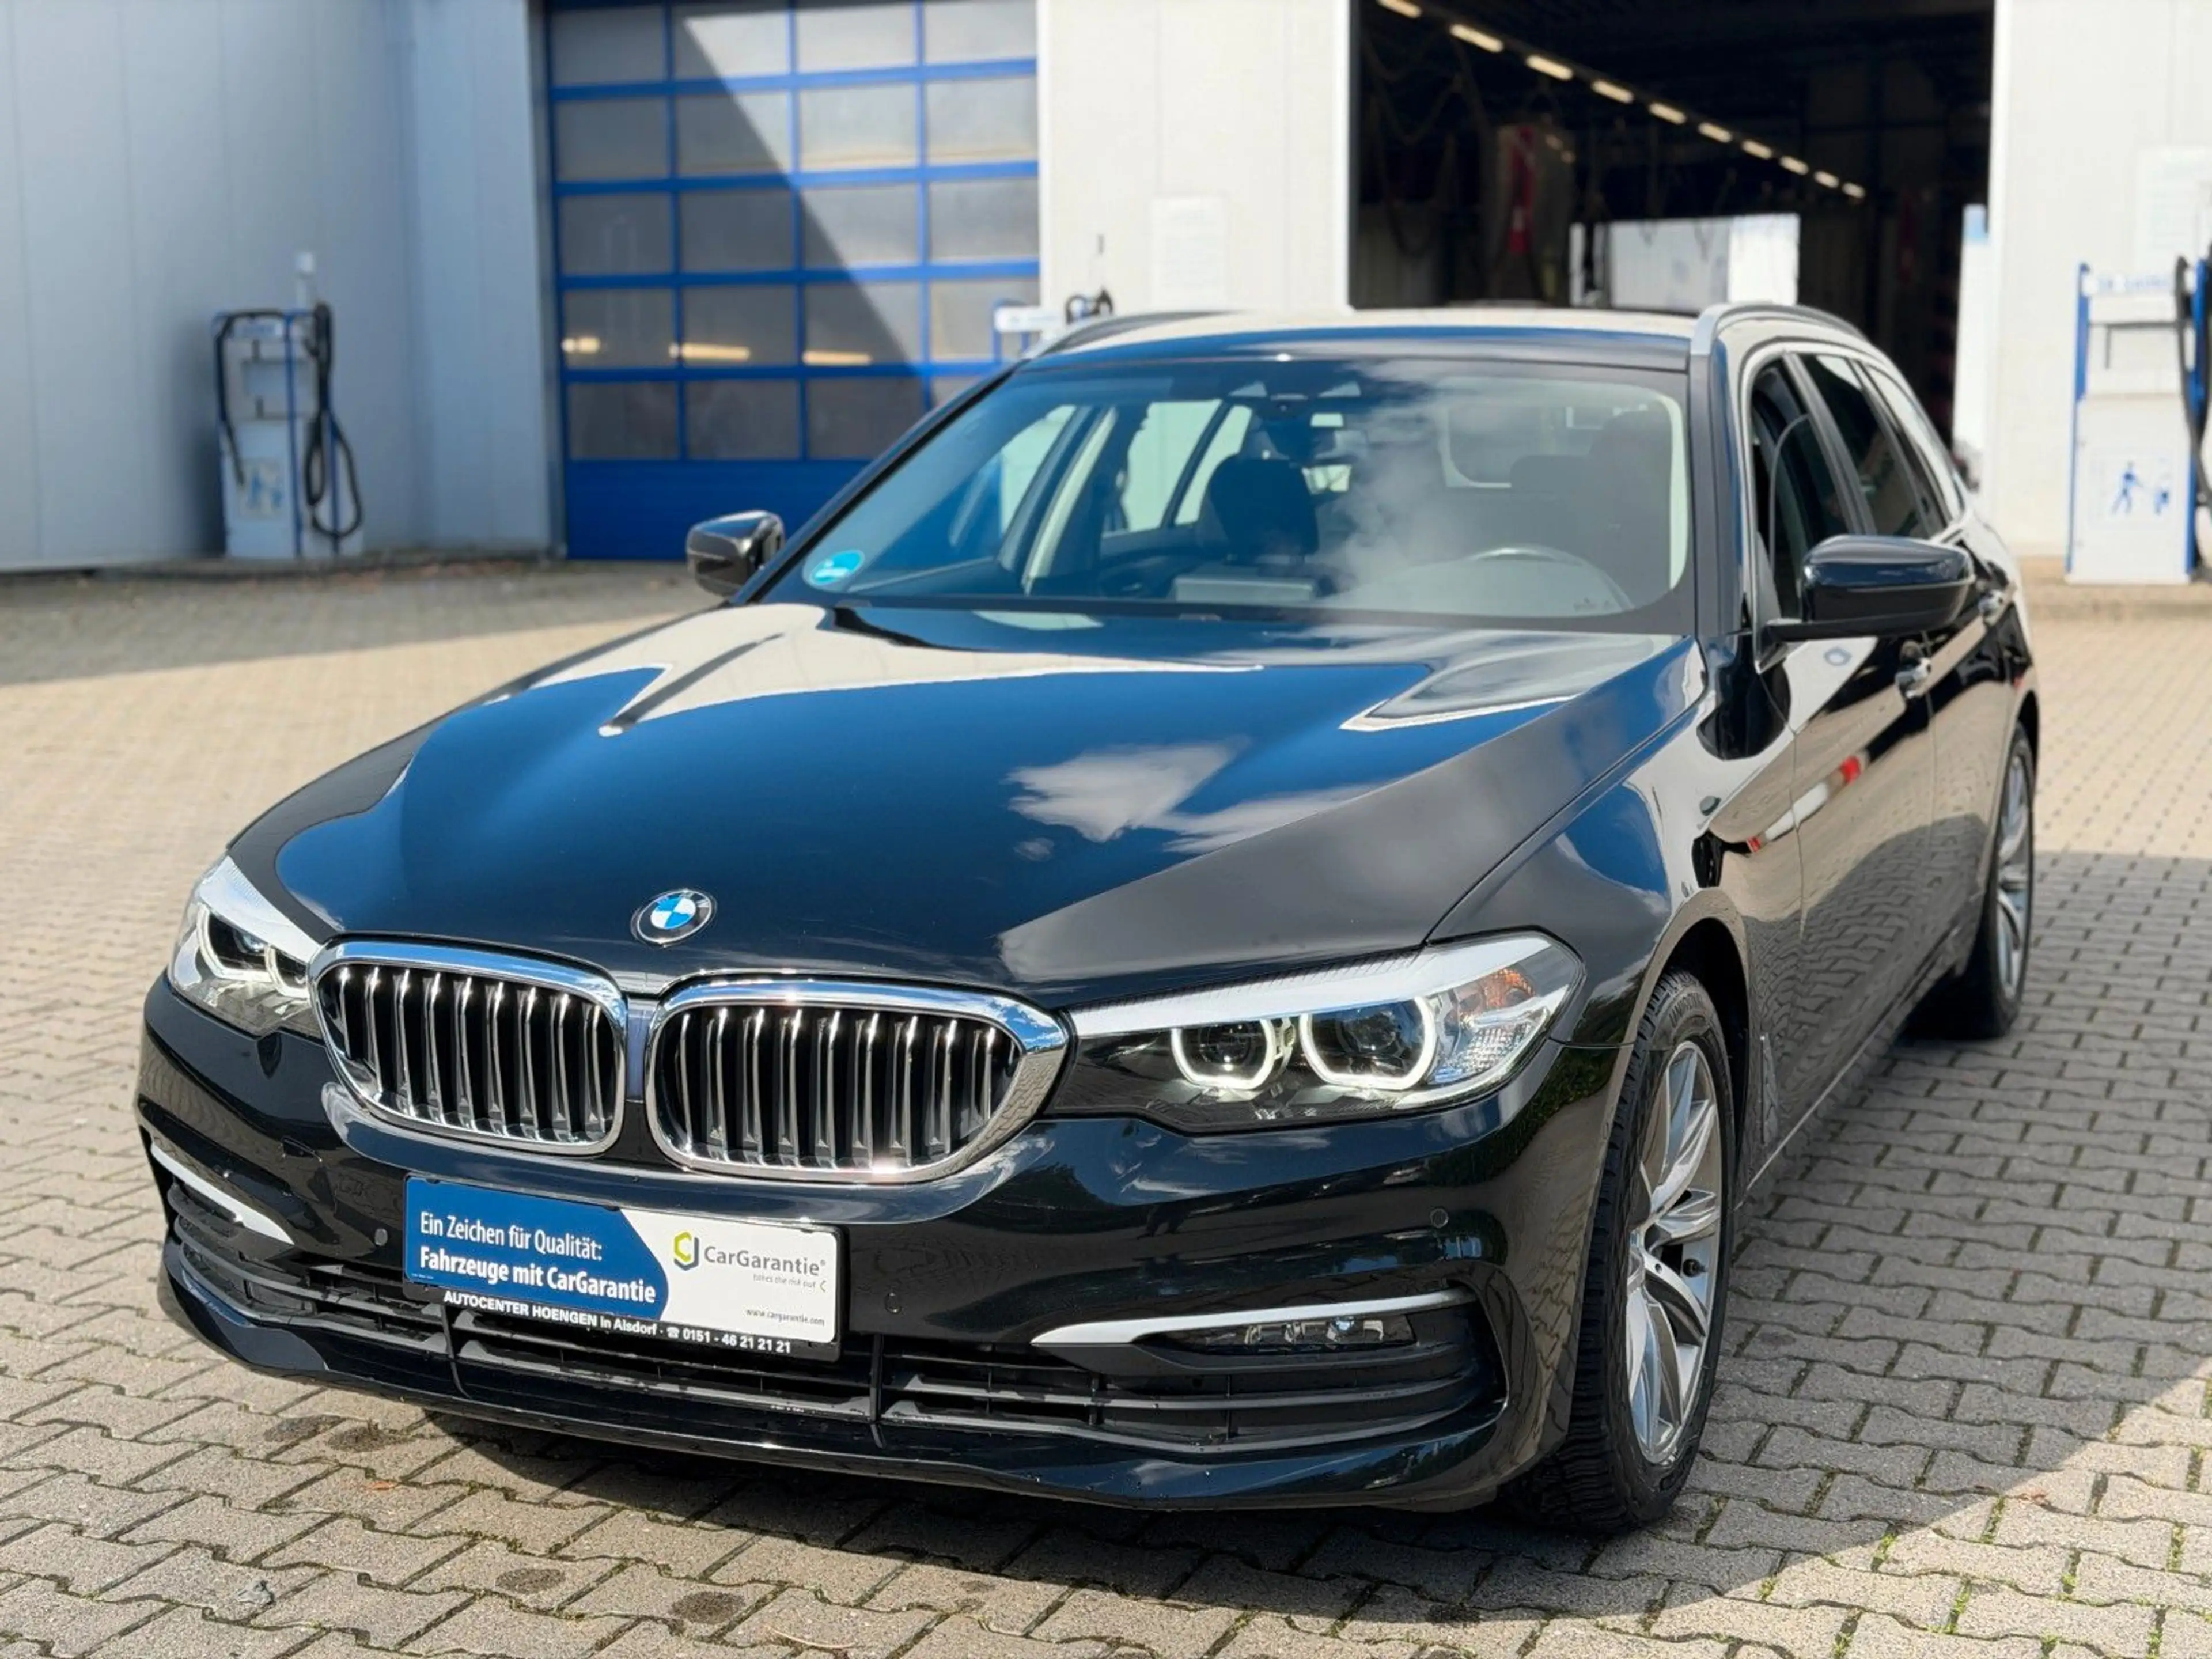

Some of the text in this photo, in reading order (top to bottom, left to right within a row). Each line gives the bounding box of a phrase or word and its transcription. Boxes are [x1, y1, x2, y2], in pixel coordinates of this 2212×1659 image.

[421, 1211, 603, 1261] Ein Zeichen für Qualität:
[420, 1246, 656, 1304] Fahrzeuge mit CarGarantie
[444, 1290, 529, 1316] AUTOCENTER
[532, 1305, 597, 1327] HOENGEN
[613, 1318, 657, 1336] Alsdorf
[683, 1327, 710, 1343] 0151
[721, 1333, 737, 1347] 46
[740, 1336, 755, 1349] 21
[757, 1338, 772, 1351] 21
[775, 1340, 791, 1354] 21
[747, 1308, 825, 1327] www.cargarantie.com
